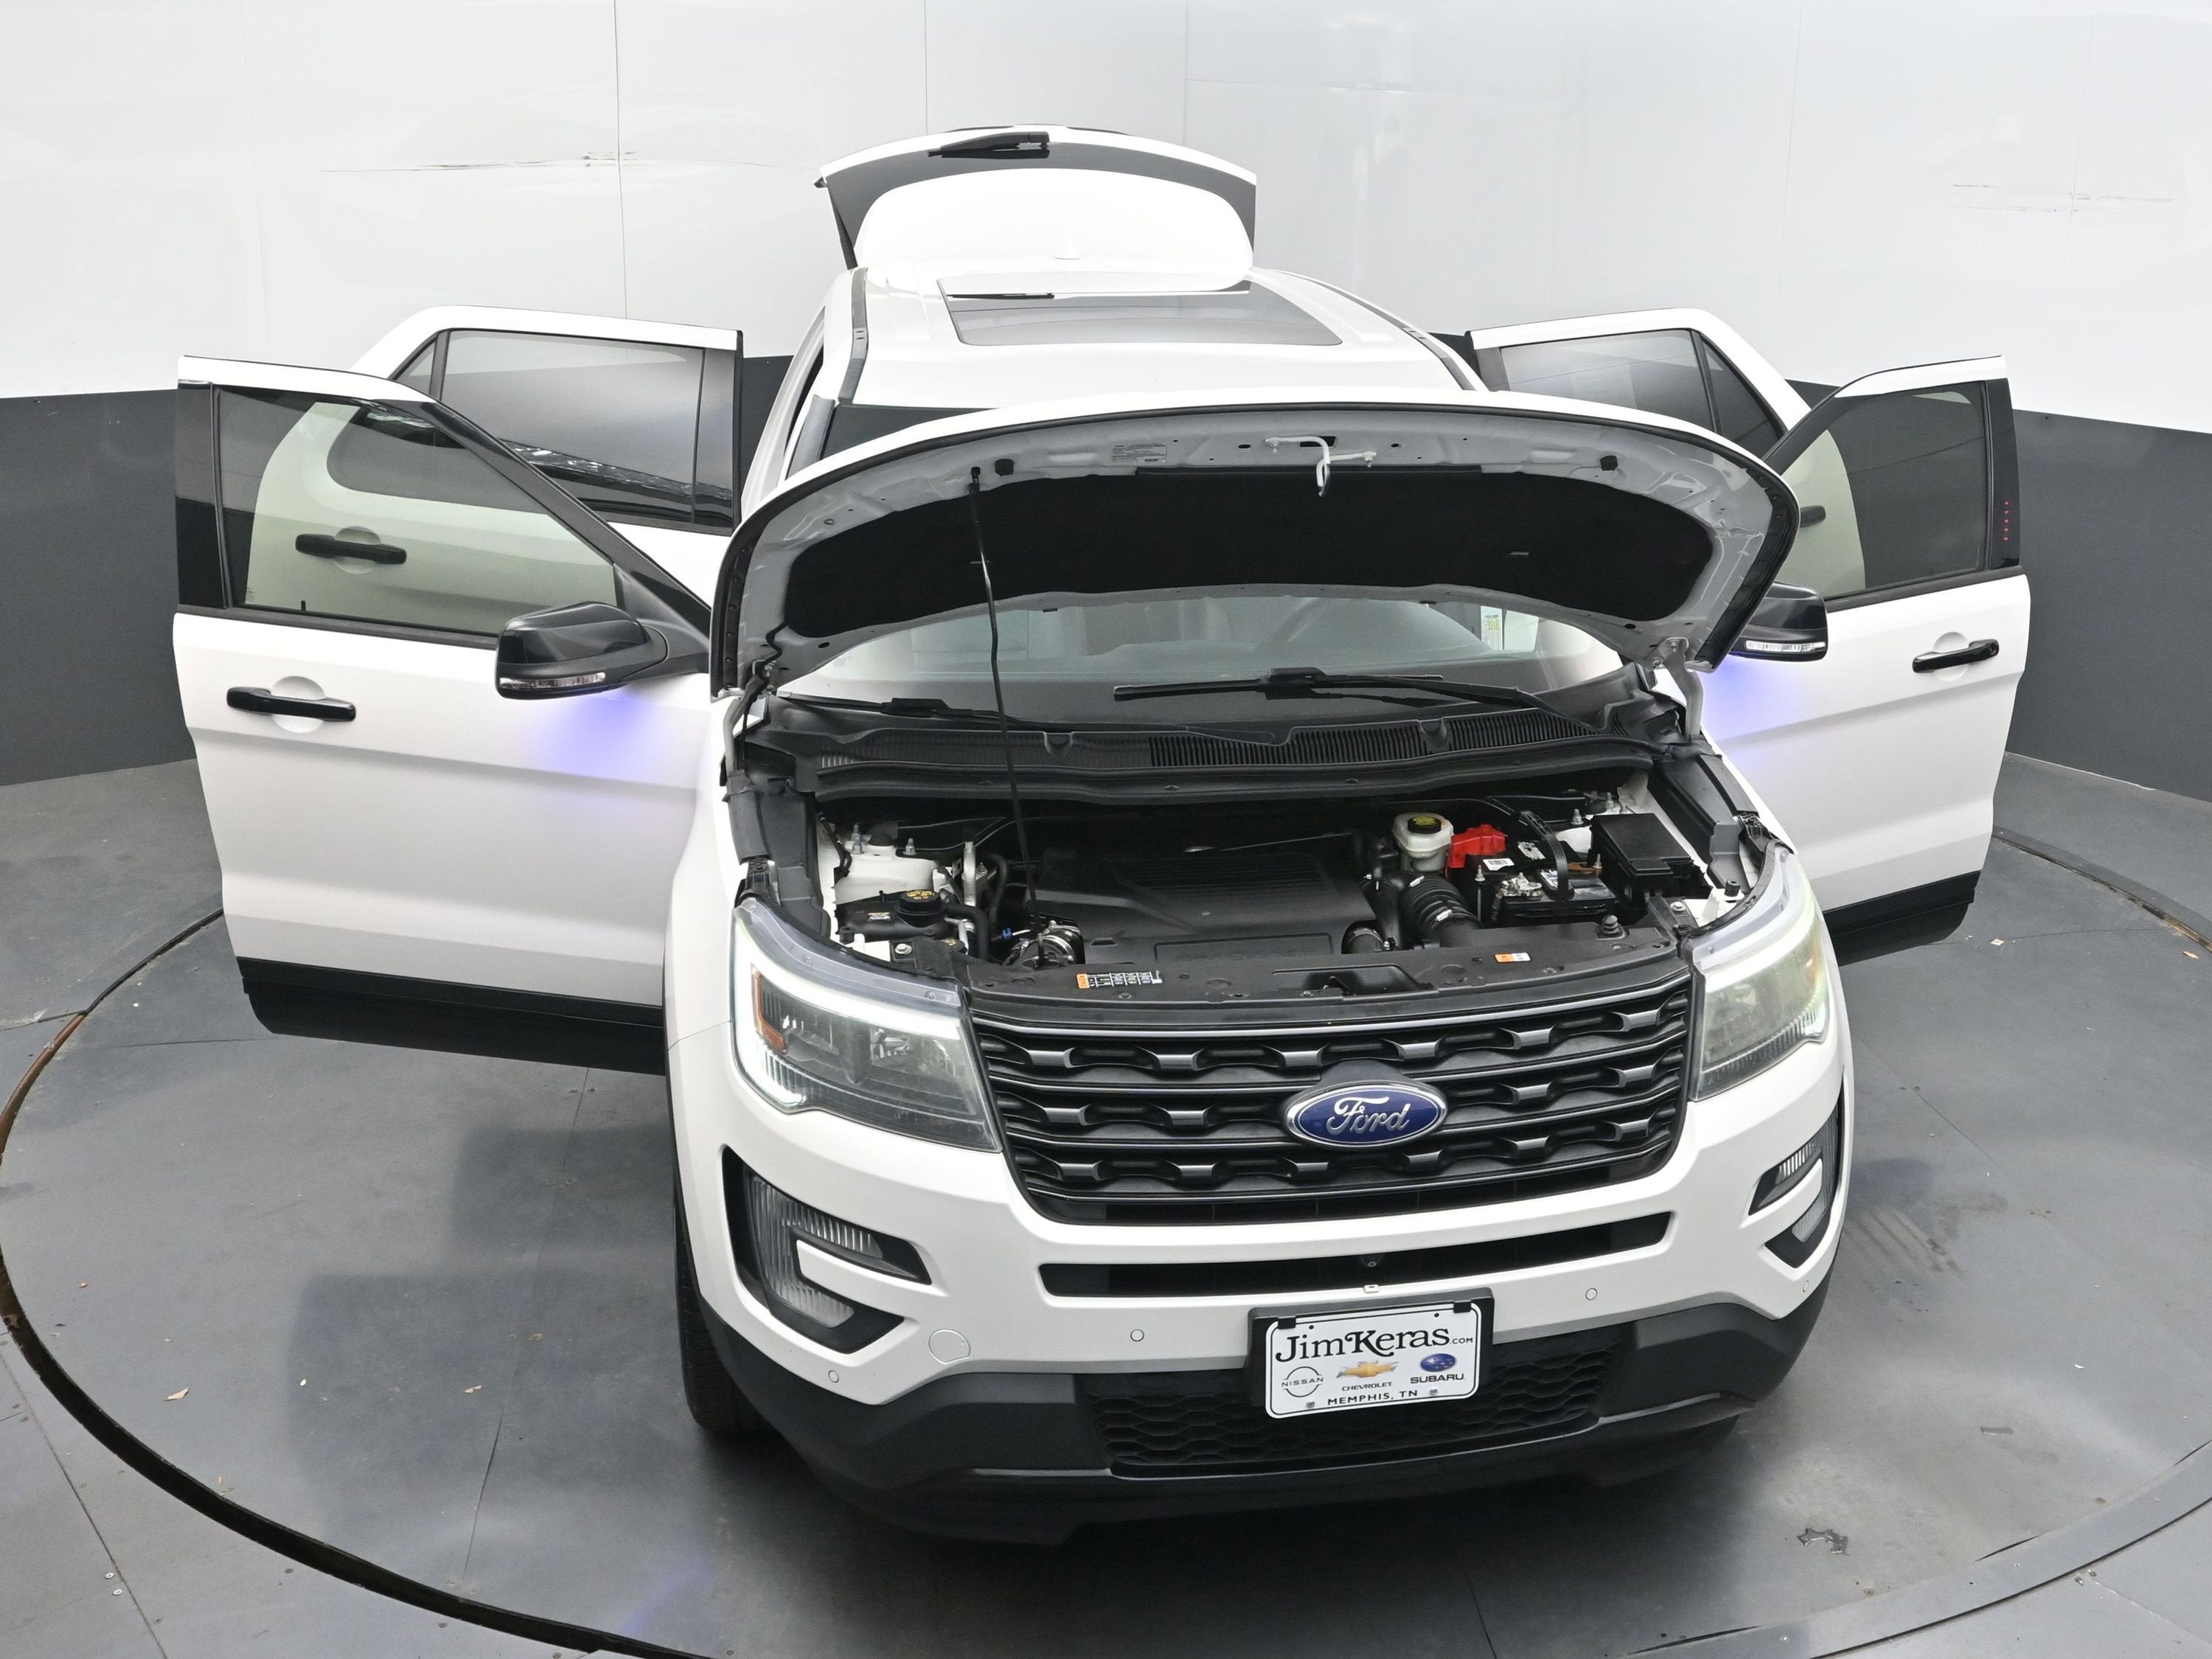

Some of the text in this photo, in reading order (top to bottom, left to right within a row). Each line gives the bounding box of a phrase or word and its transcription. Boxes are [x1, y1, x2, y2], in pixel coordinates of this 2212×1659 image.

[1326, 1096, 1411, 1135] Ford
[1281, 1377, 1324, 1387] NISSAN
[1410, 1373, 1464, 1384] SUBARU
[1341, 1382, 1393, 1391] CHEVROLET
[1399, 1390, 1418, 1398] TN
